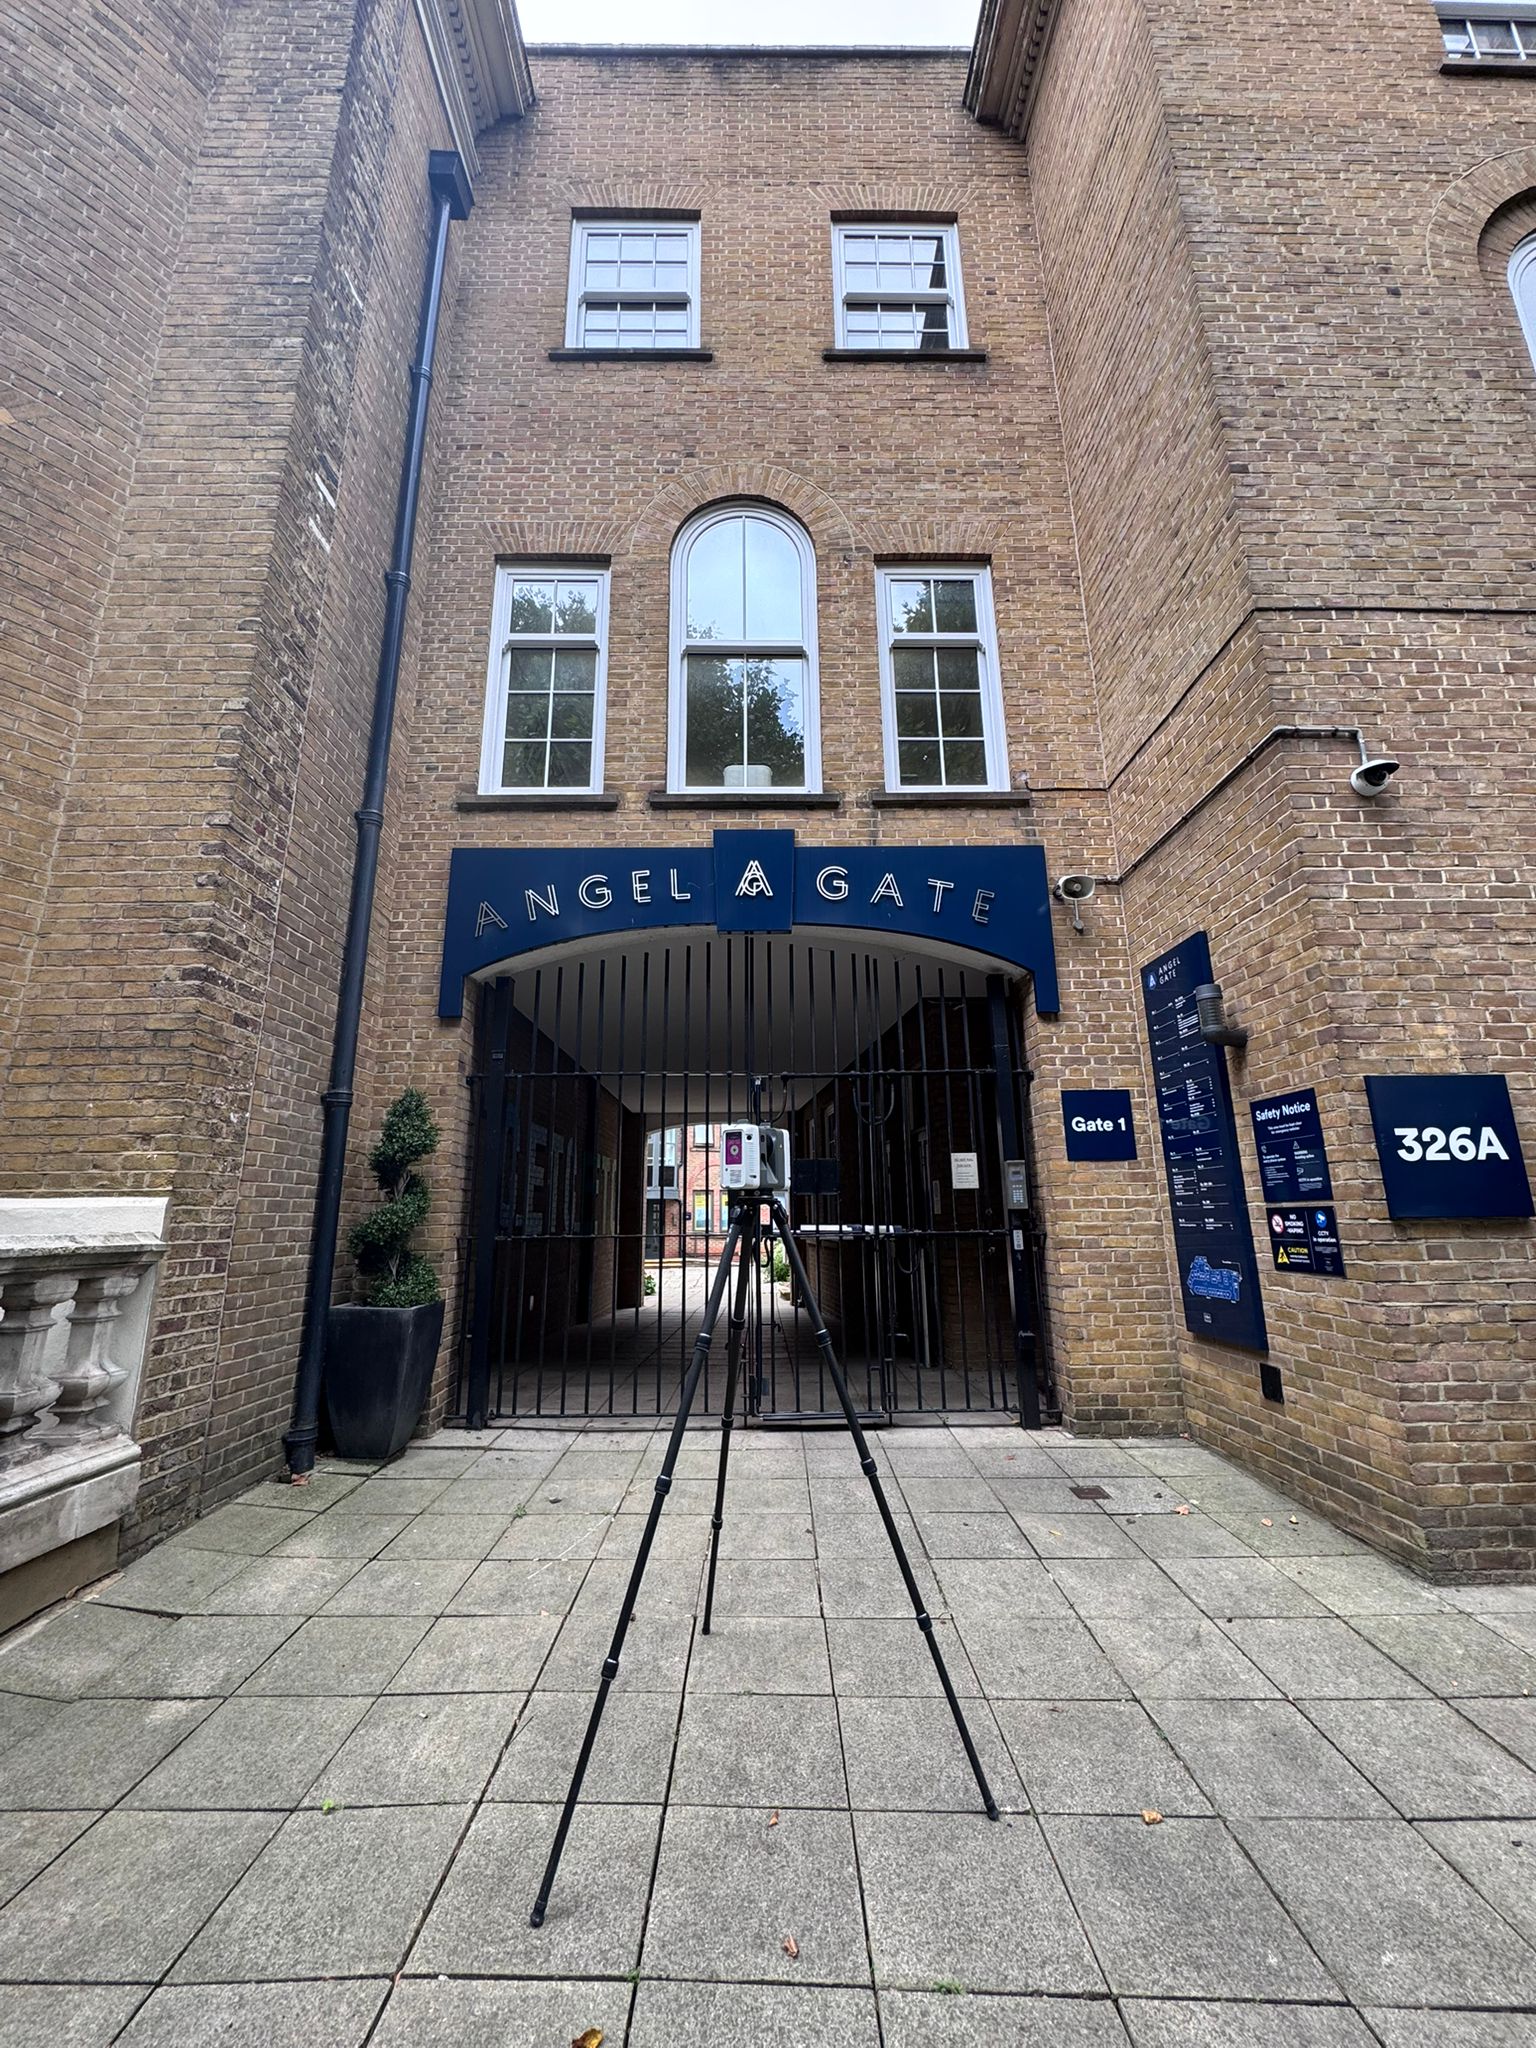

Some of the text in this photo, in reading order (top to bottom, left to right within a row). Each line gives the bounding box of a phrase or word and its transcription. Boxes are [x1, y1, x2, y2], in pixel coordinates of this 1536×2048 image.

[474, 867, 691, 938] ANGEL
[816, 865, 995, 925] GATE
[1158, 956, 1181, 976] ANGEL
[1159, 968, 1176, 985] GATE
[1255, 1101, 1311, 1121] Safety Notice
[1071, 1116, 1126, 1132] Gate 1
[1393, 1126, 1510, 1162] 326A
[1287, 1246, 1308, 1254] CAUTION
